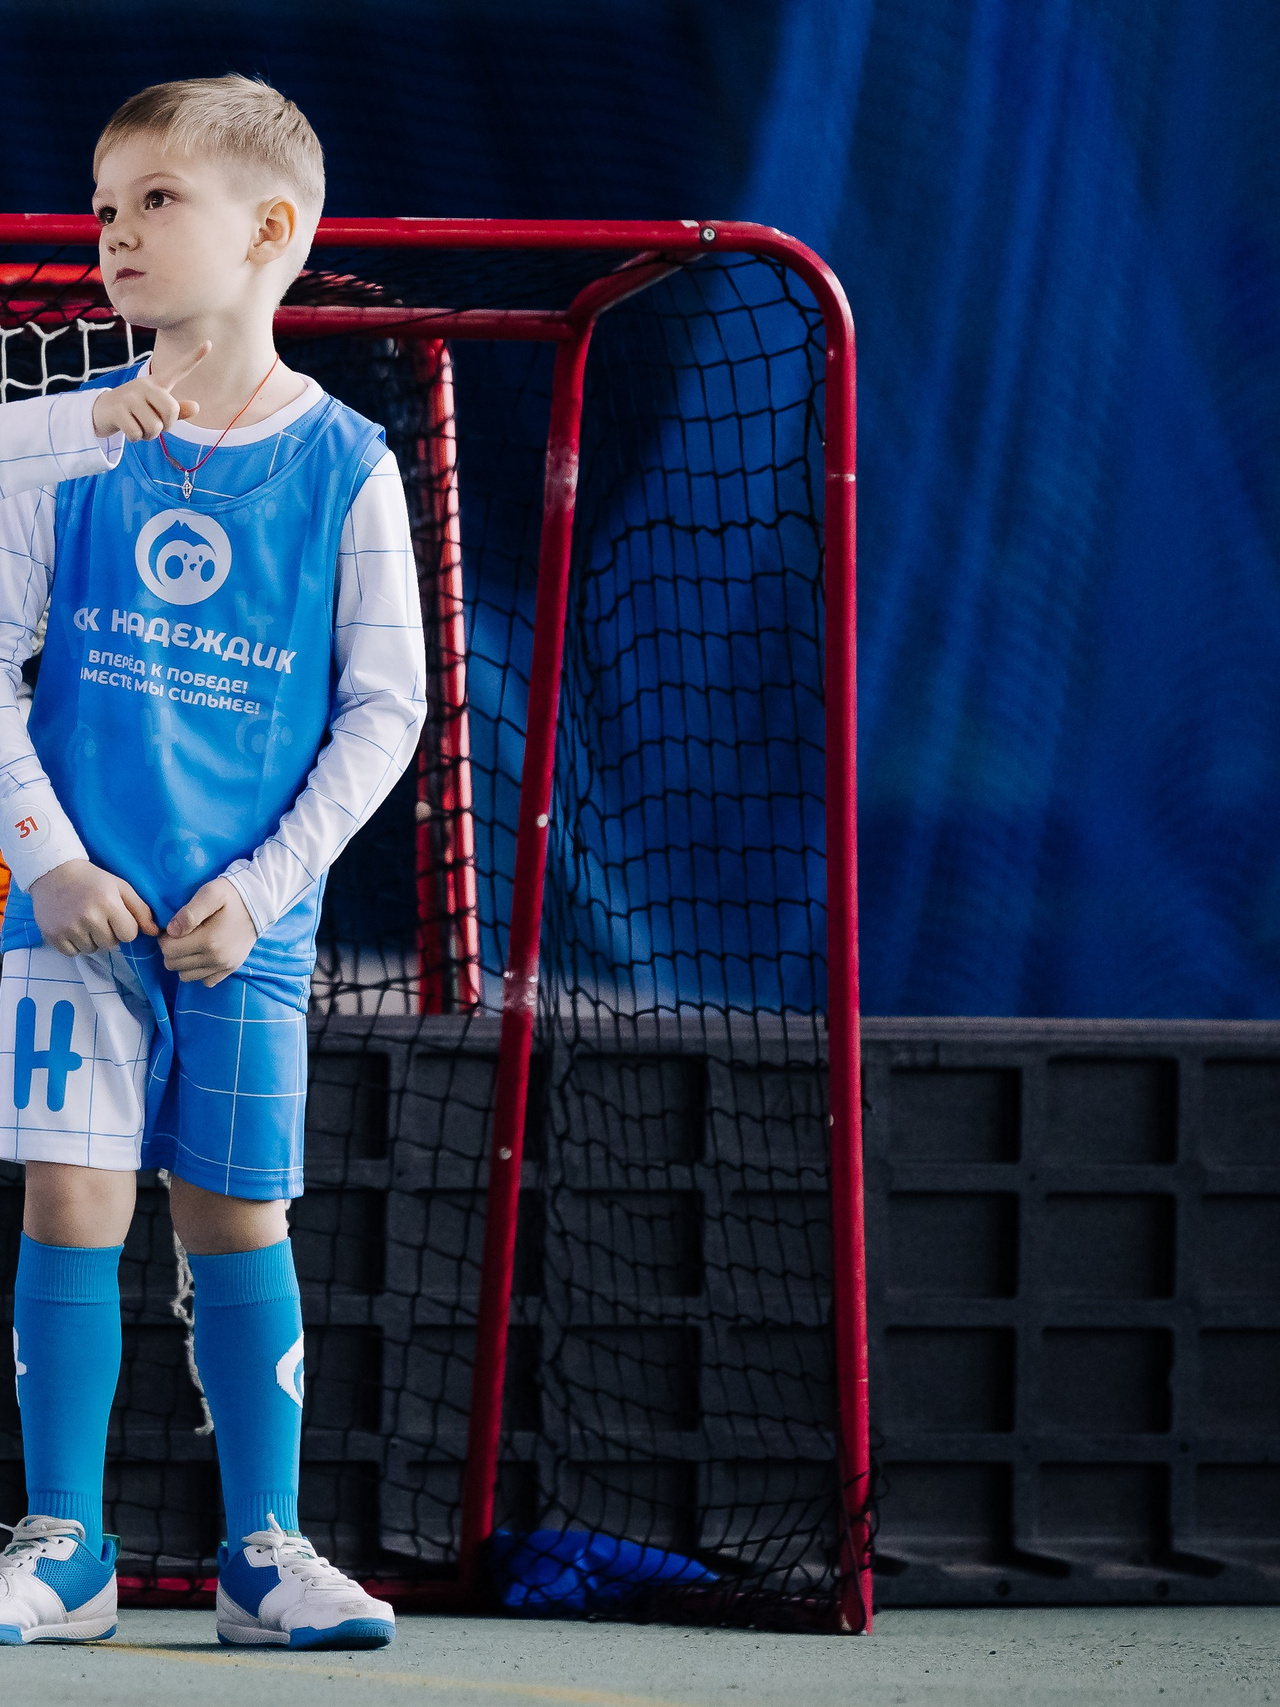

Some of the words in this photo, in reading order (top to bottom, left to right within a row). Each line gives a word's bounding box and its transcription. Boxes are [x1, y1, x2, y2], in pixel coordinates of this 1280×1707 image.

[111, 608, 298, 675] НАДЕЖДИК
[88, 649, 146, 677] ВПЕРЁД
[150, 662, 163, 678] К
[166, 667, 249, 695] ПОБЕДЕ!
[134, 678, 165, 697] МЫ
[168, 687, 261, 715] СИЛЬНЕЕ!
[14, 816, 38, 839] 31
